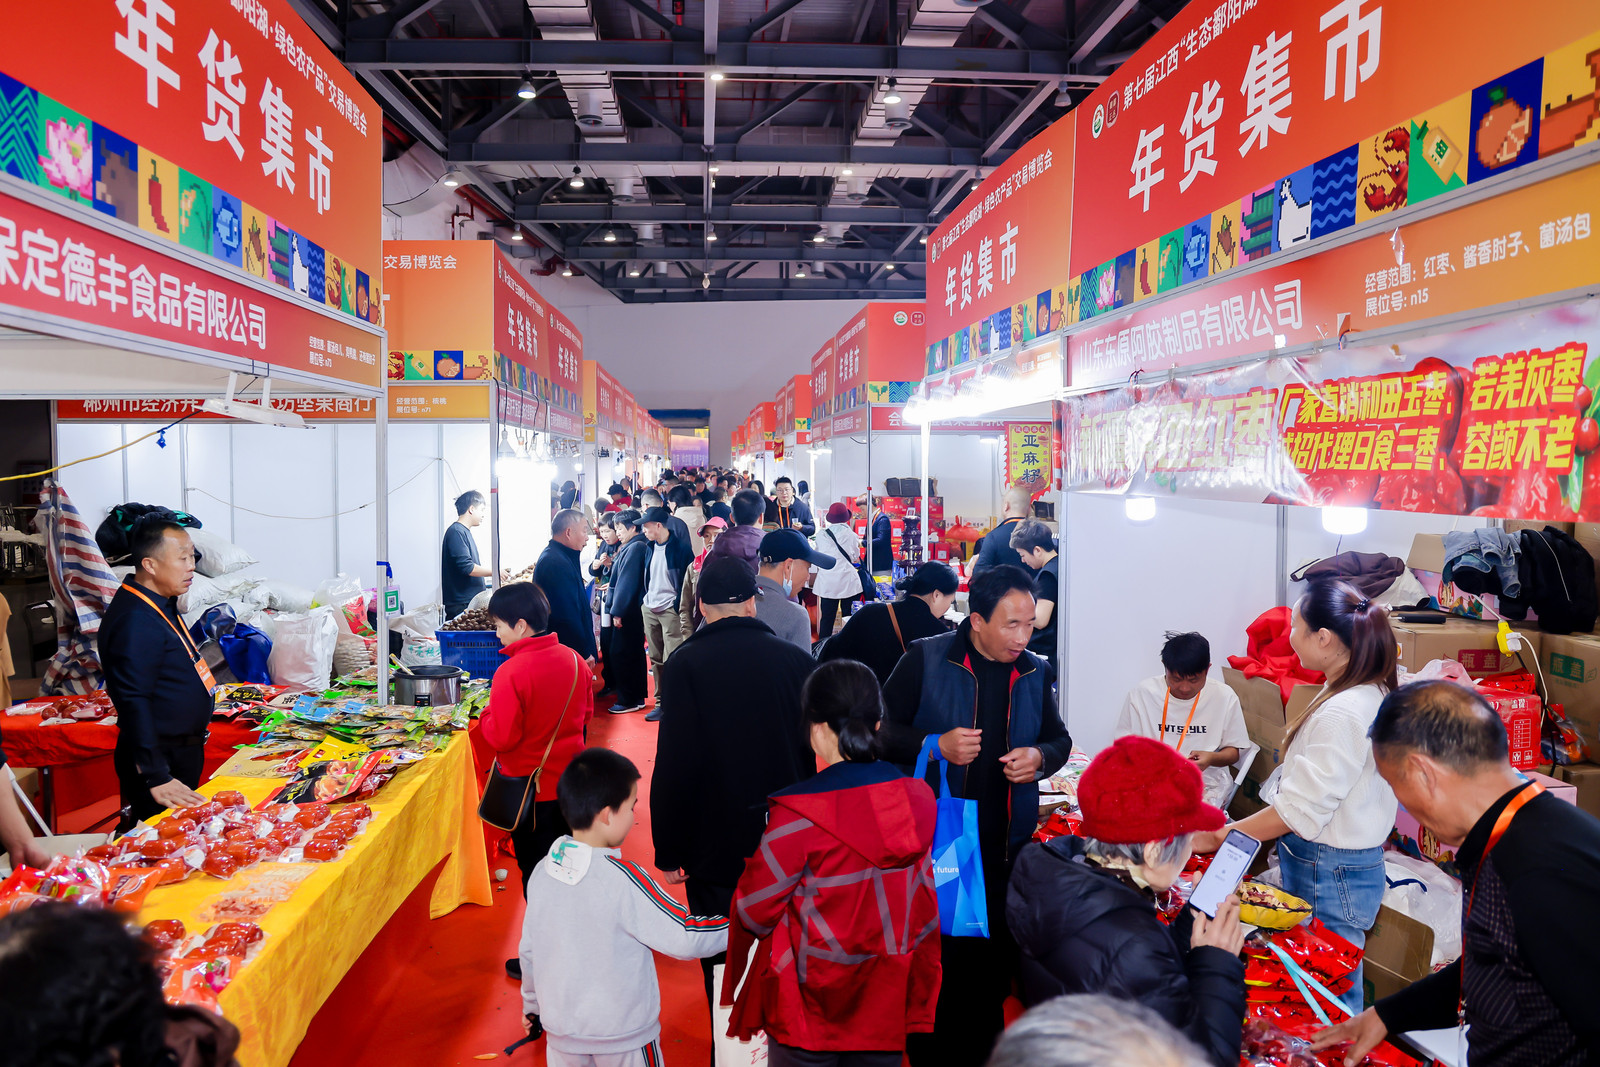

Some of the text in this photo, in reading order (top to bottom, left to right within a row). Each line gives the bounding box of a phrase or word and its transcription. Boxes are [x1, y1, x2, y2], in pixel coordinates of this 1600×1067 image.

[115, 0, 334, 215] 年货集市
[1128, 0, 1382, 213] 年货集市
[384, 254, 457, 270] 交易博览会
[945, 221, 1019, 316] 年货集市
[1080, 279, 1303, 372] 山东东原阿胶制品有限公司
[1021, 434, 1041, 483] 亚麻籽
[1177, 725, 1207, 734] SYLE
[937, 866, 959, 874] future
